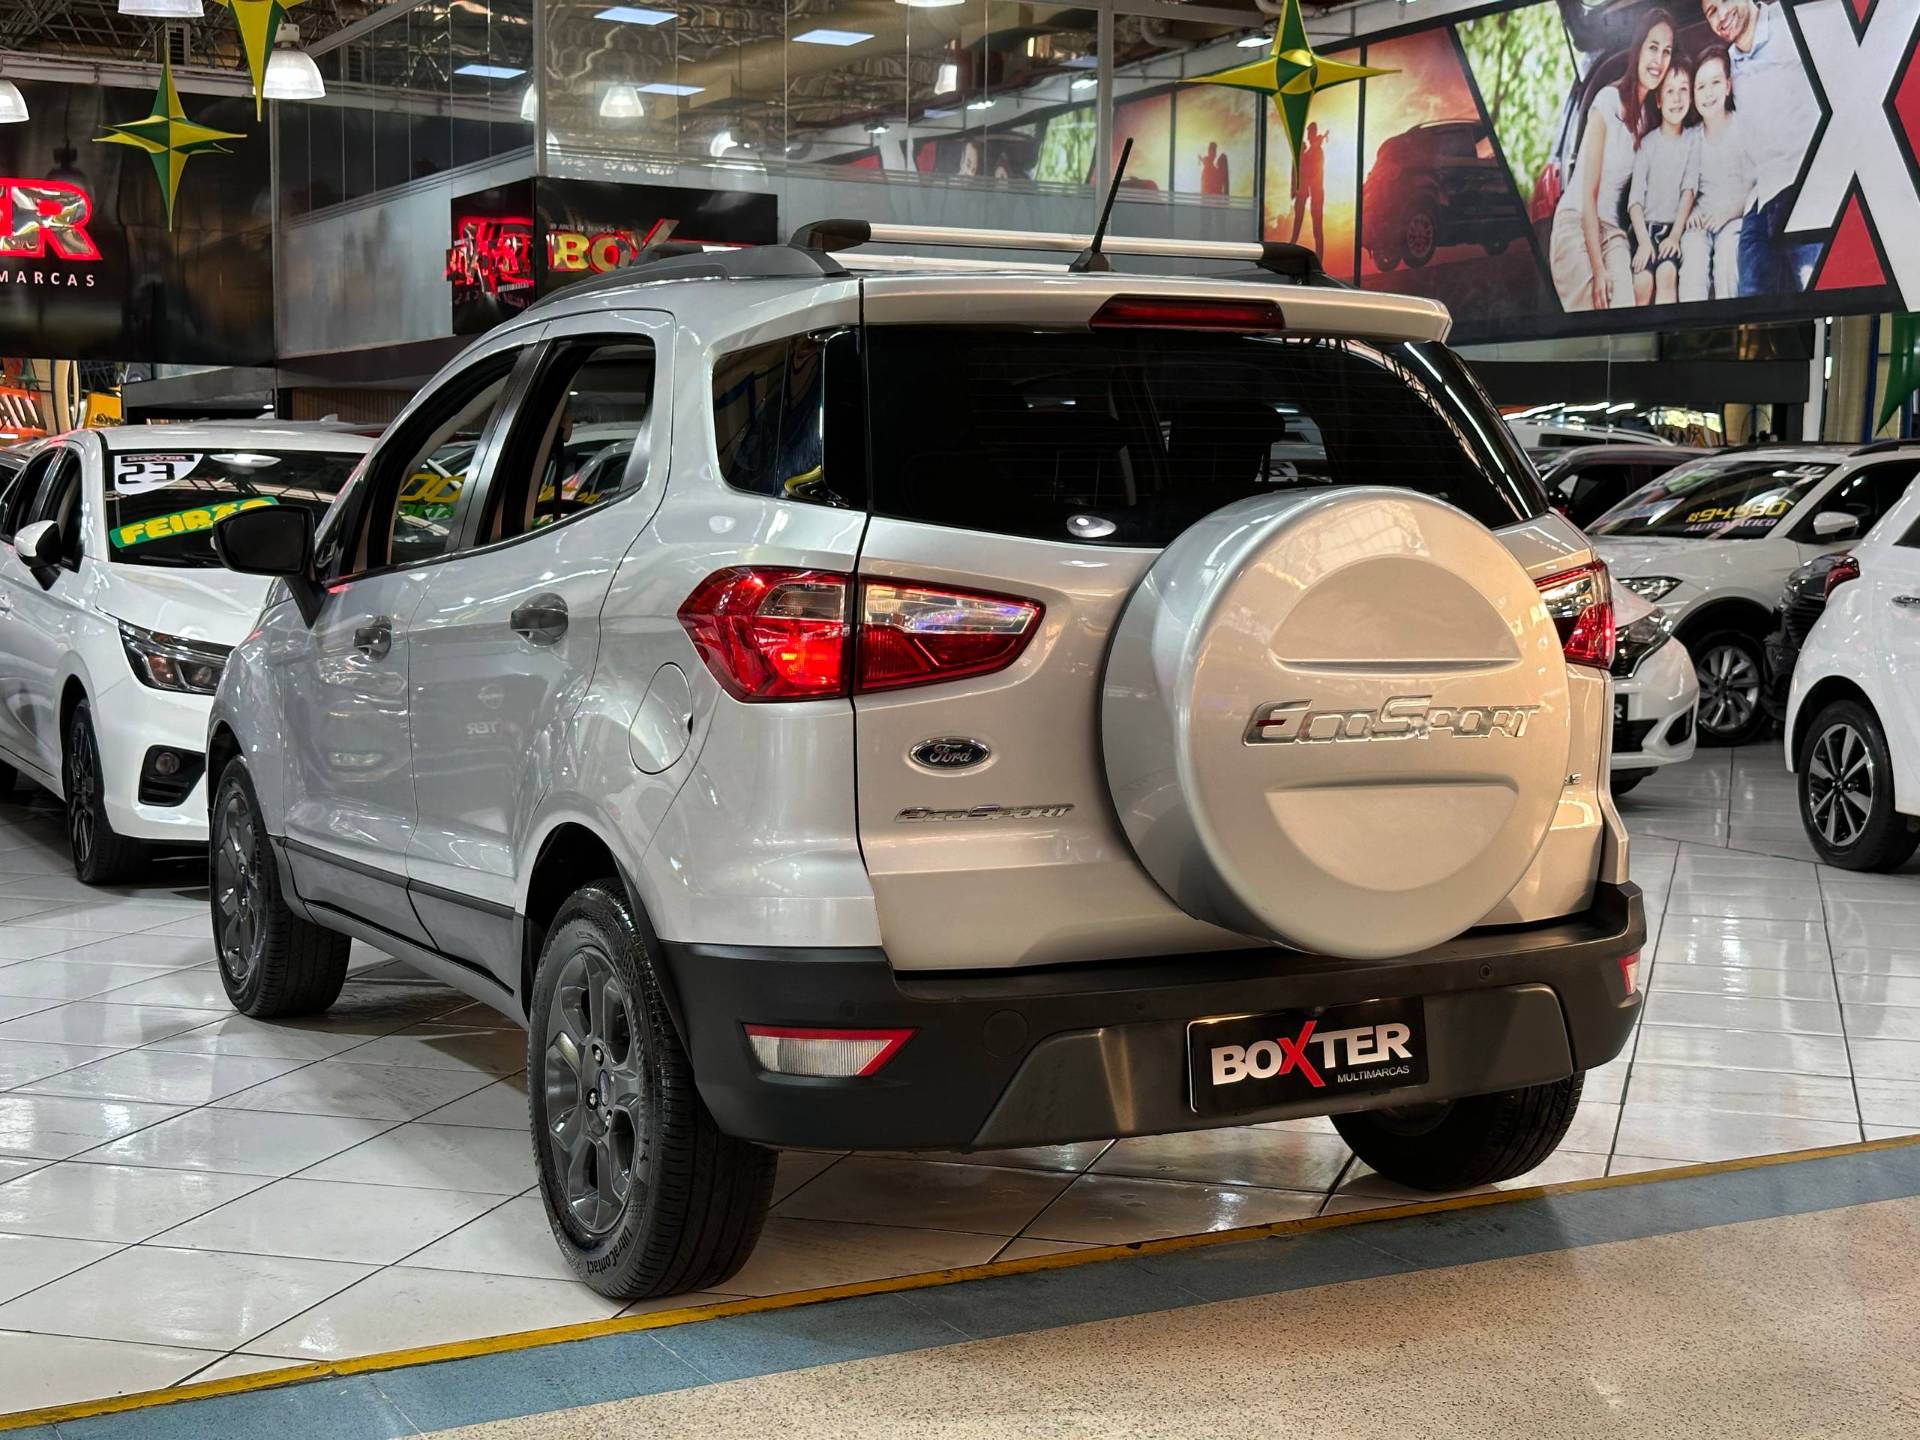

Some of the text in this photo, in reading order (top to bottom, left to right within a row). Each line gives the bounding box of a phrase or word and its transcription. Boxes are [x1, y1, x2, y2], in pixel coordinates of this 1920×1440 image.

[0, 177, 103, 260] R
[118, 463, 176, 484] 23
[120, 500, 273, 544] FEIR
[929, 743, 972, 763] Ford
[1211, 1020, 1413, 1088] BOXTER
[1337, 1065, 1410, 1083] MULTIMARCAS
